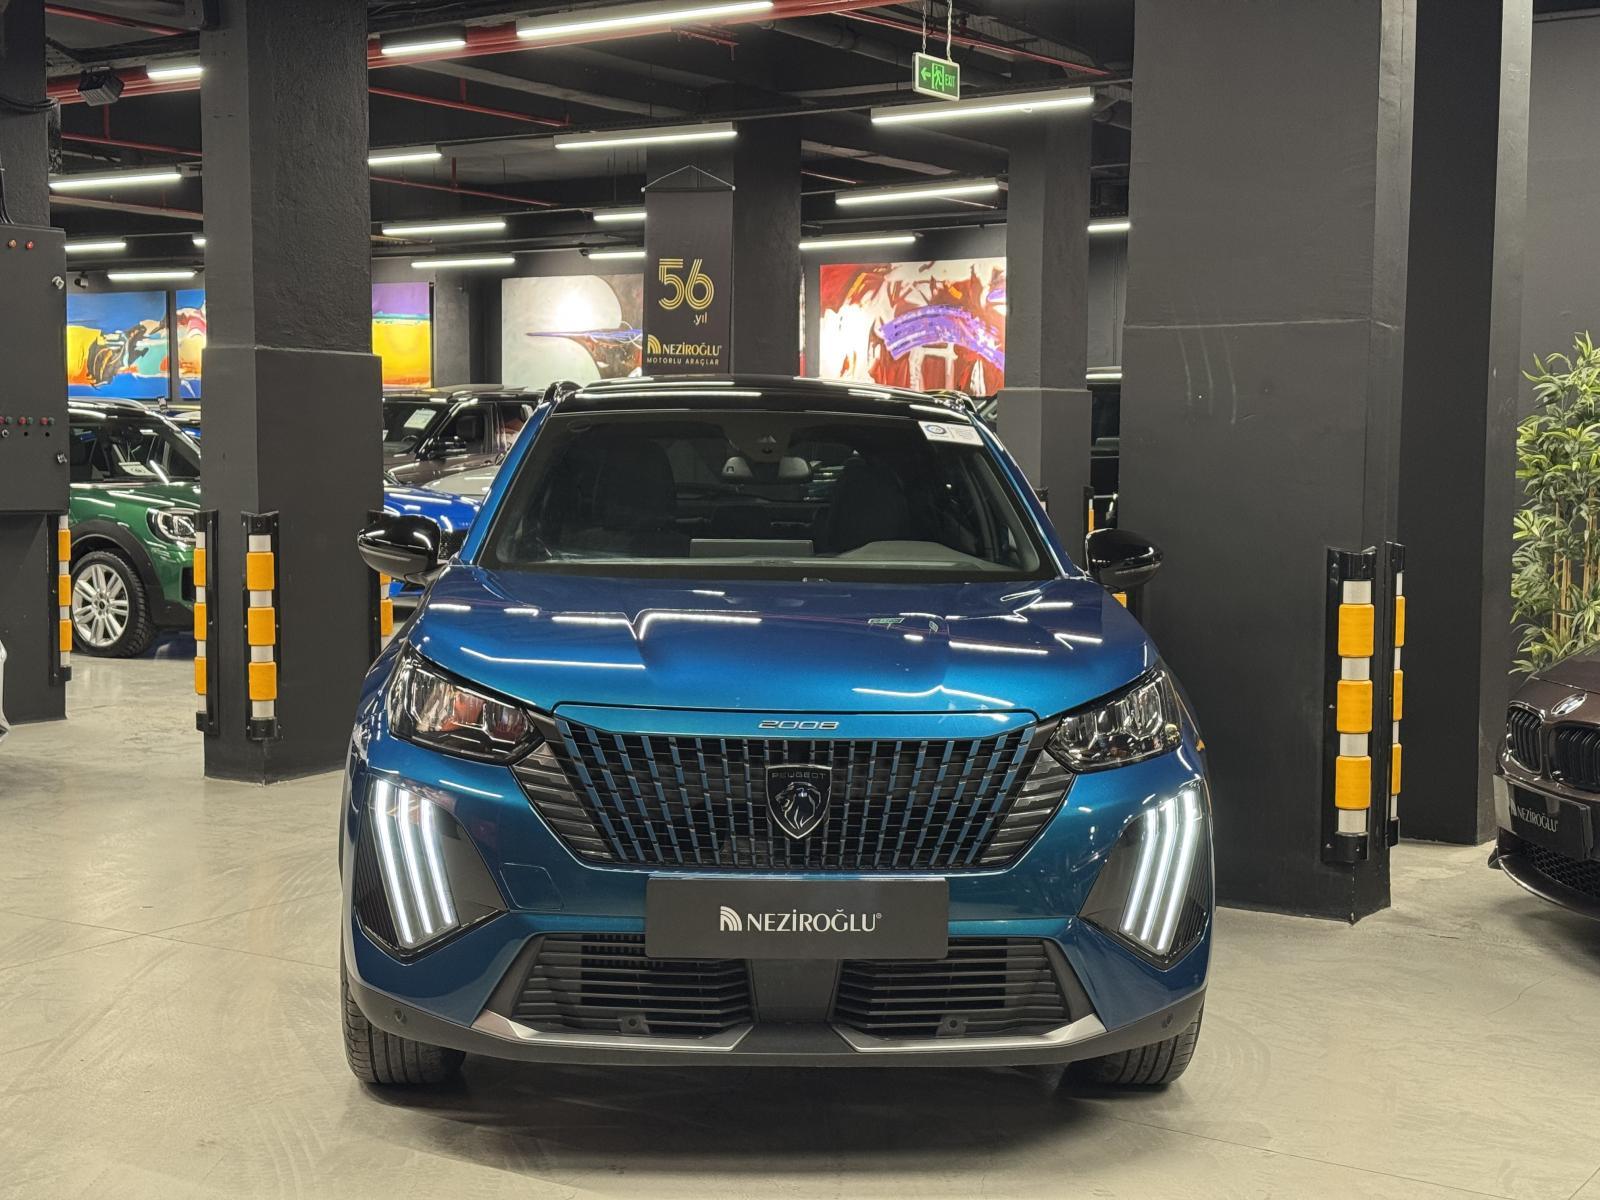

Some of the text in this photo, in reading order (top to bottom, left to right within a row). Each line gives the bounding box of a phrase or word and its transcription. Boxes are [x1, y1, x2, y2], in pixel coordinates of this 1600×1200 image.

[944, 73, 956, 88] EXIT
[658, 258, 715, 310] 56
[646, 357, 719, 367] MOTORLU ARAÇLAR
[758, 720, 840, 730] 2008
[771, 771, 827, 779] PEUGEOT
[747, 908, 876, 932] NEZİROĞLU
